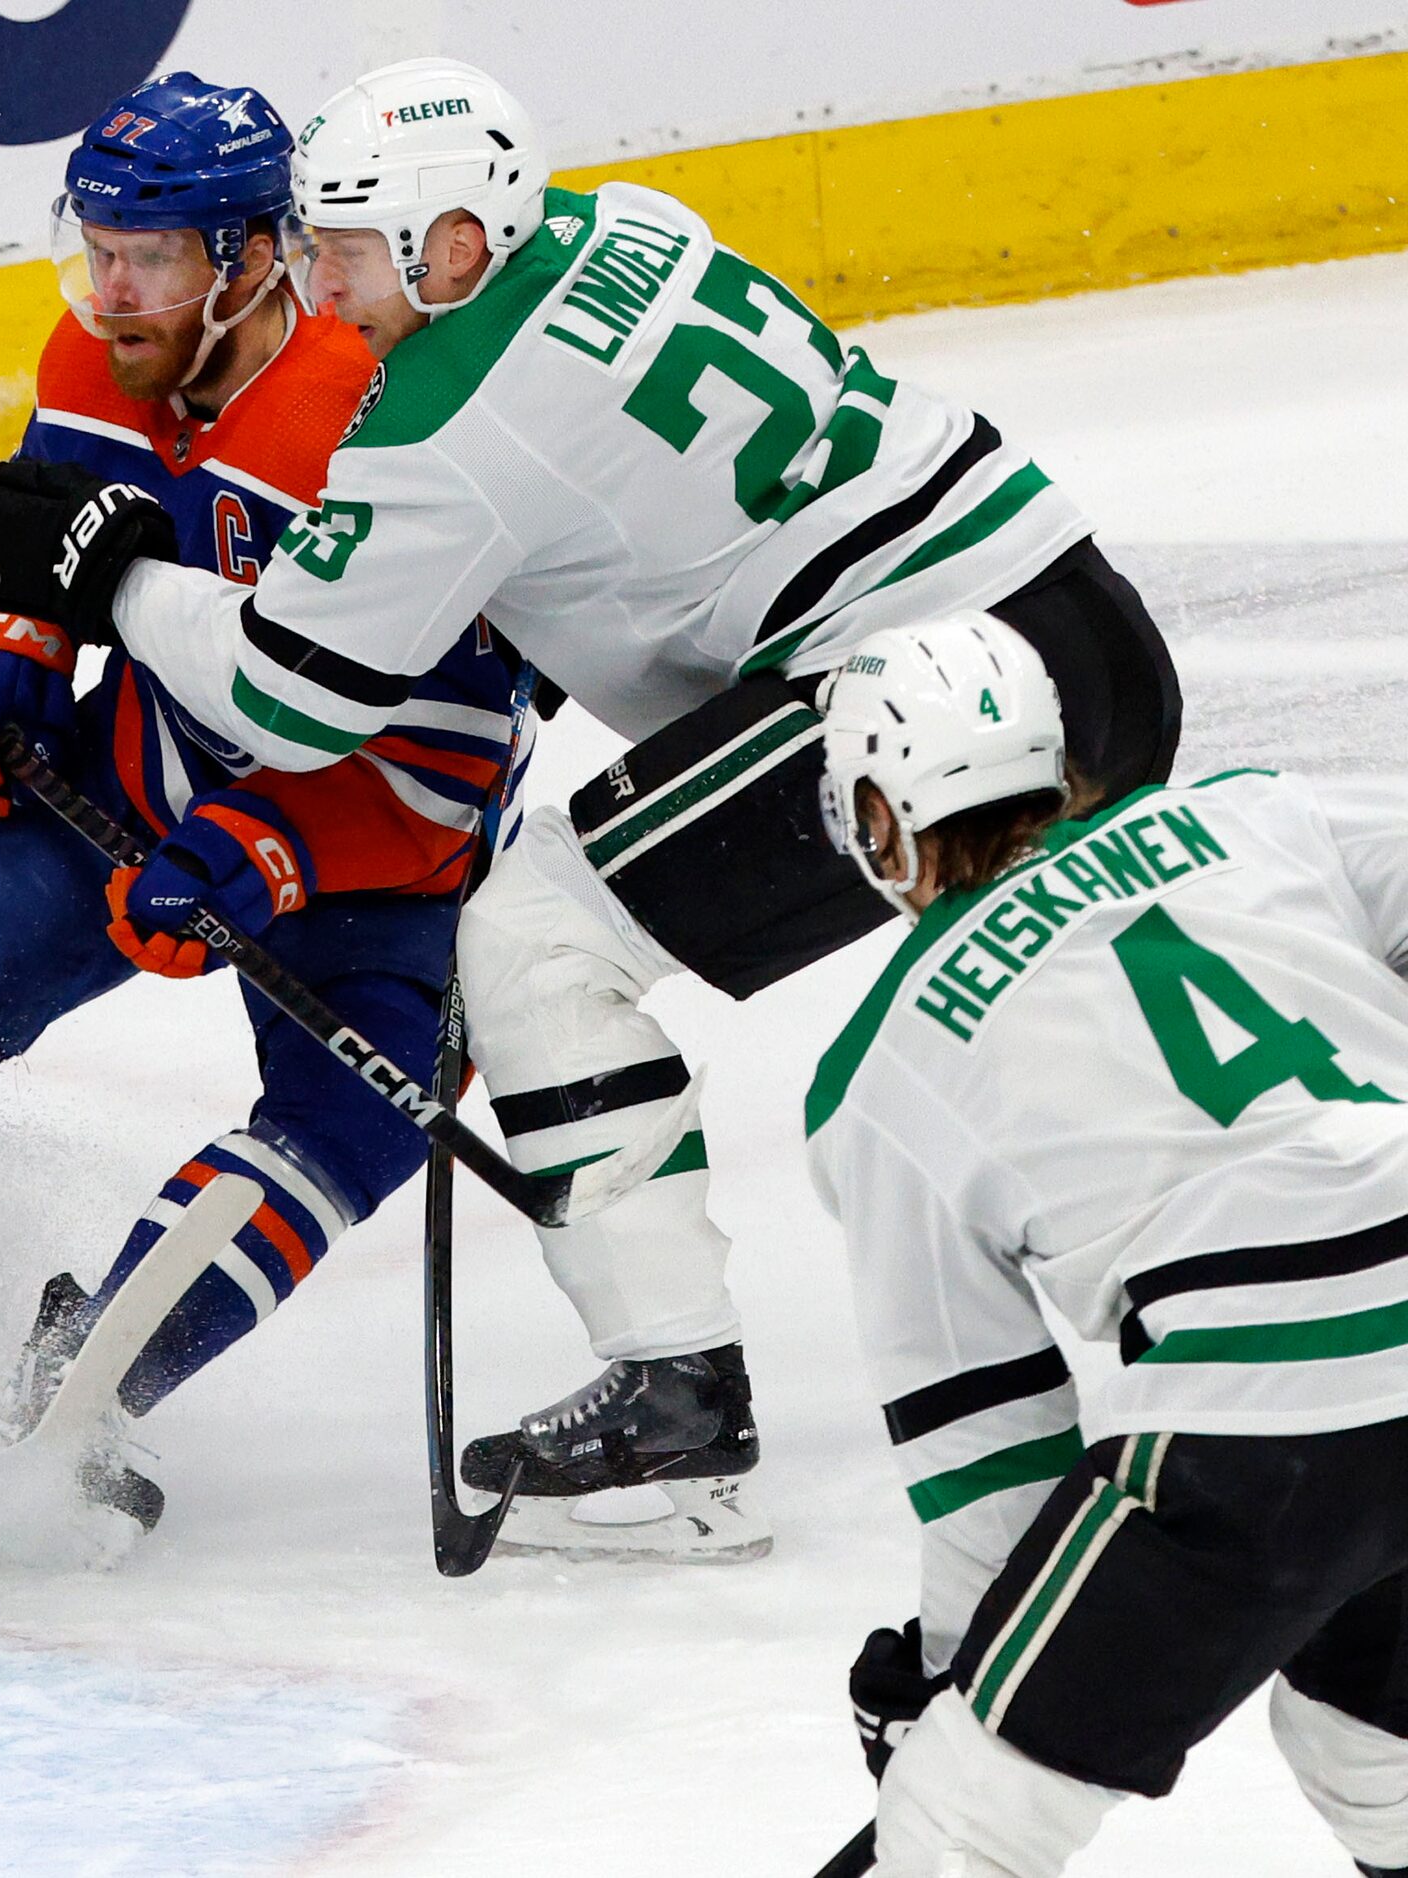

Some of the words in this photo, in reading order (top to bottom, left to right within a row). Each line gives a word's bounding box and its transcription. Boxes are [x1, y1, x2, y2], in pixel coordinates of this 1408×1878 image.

[102, 111, 158, 144] 97
[381, 98, 471, 128] 7-ELEVEN
[76, 176, 122, 197] CCM
[543, 218, 691, 367] LINDELL
[213, 490, 261, 586] C
[979, 688, 1002, 723] 4
[915, 804, 1230, 1043] HEISKANEN
[1110, 902, 1408, 1128] 4
[328, 1027, 445, 1128] CCM
